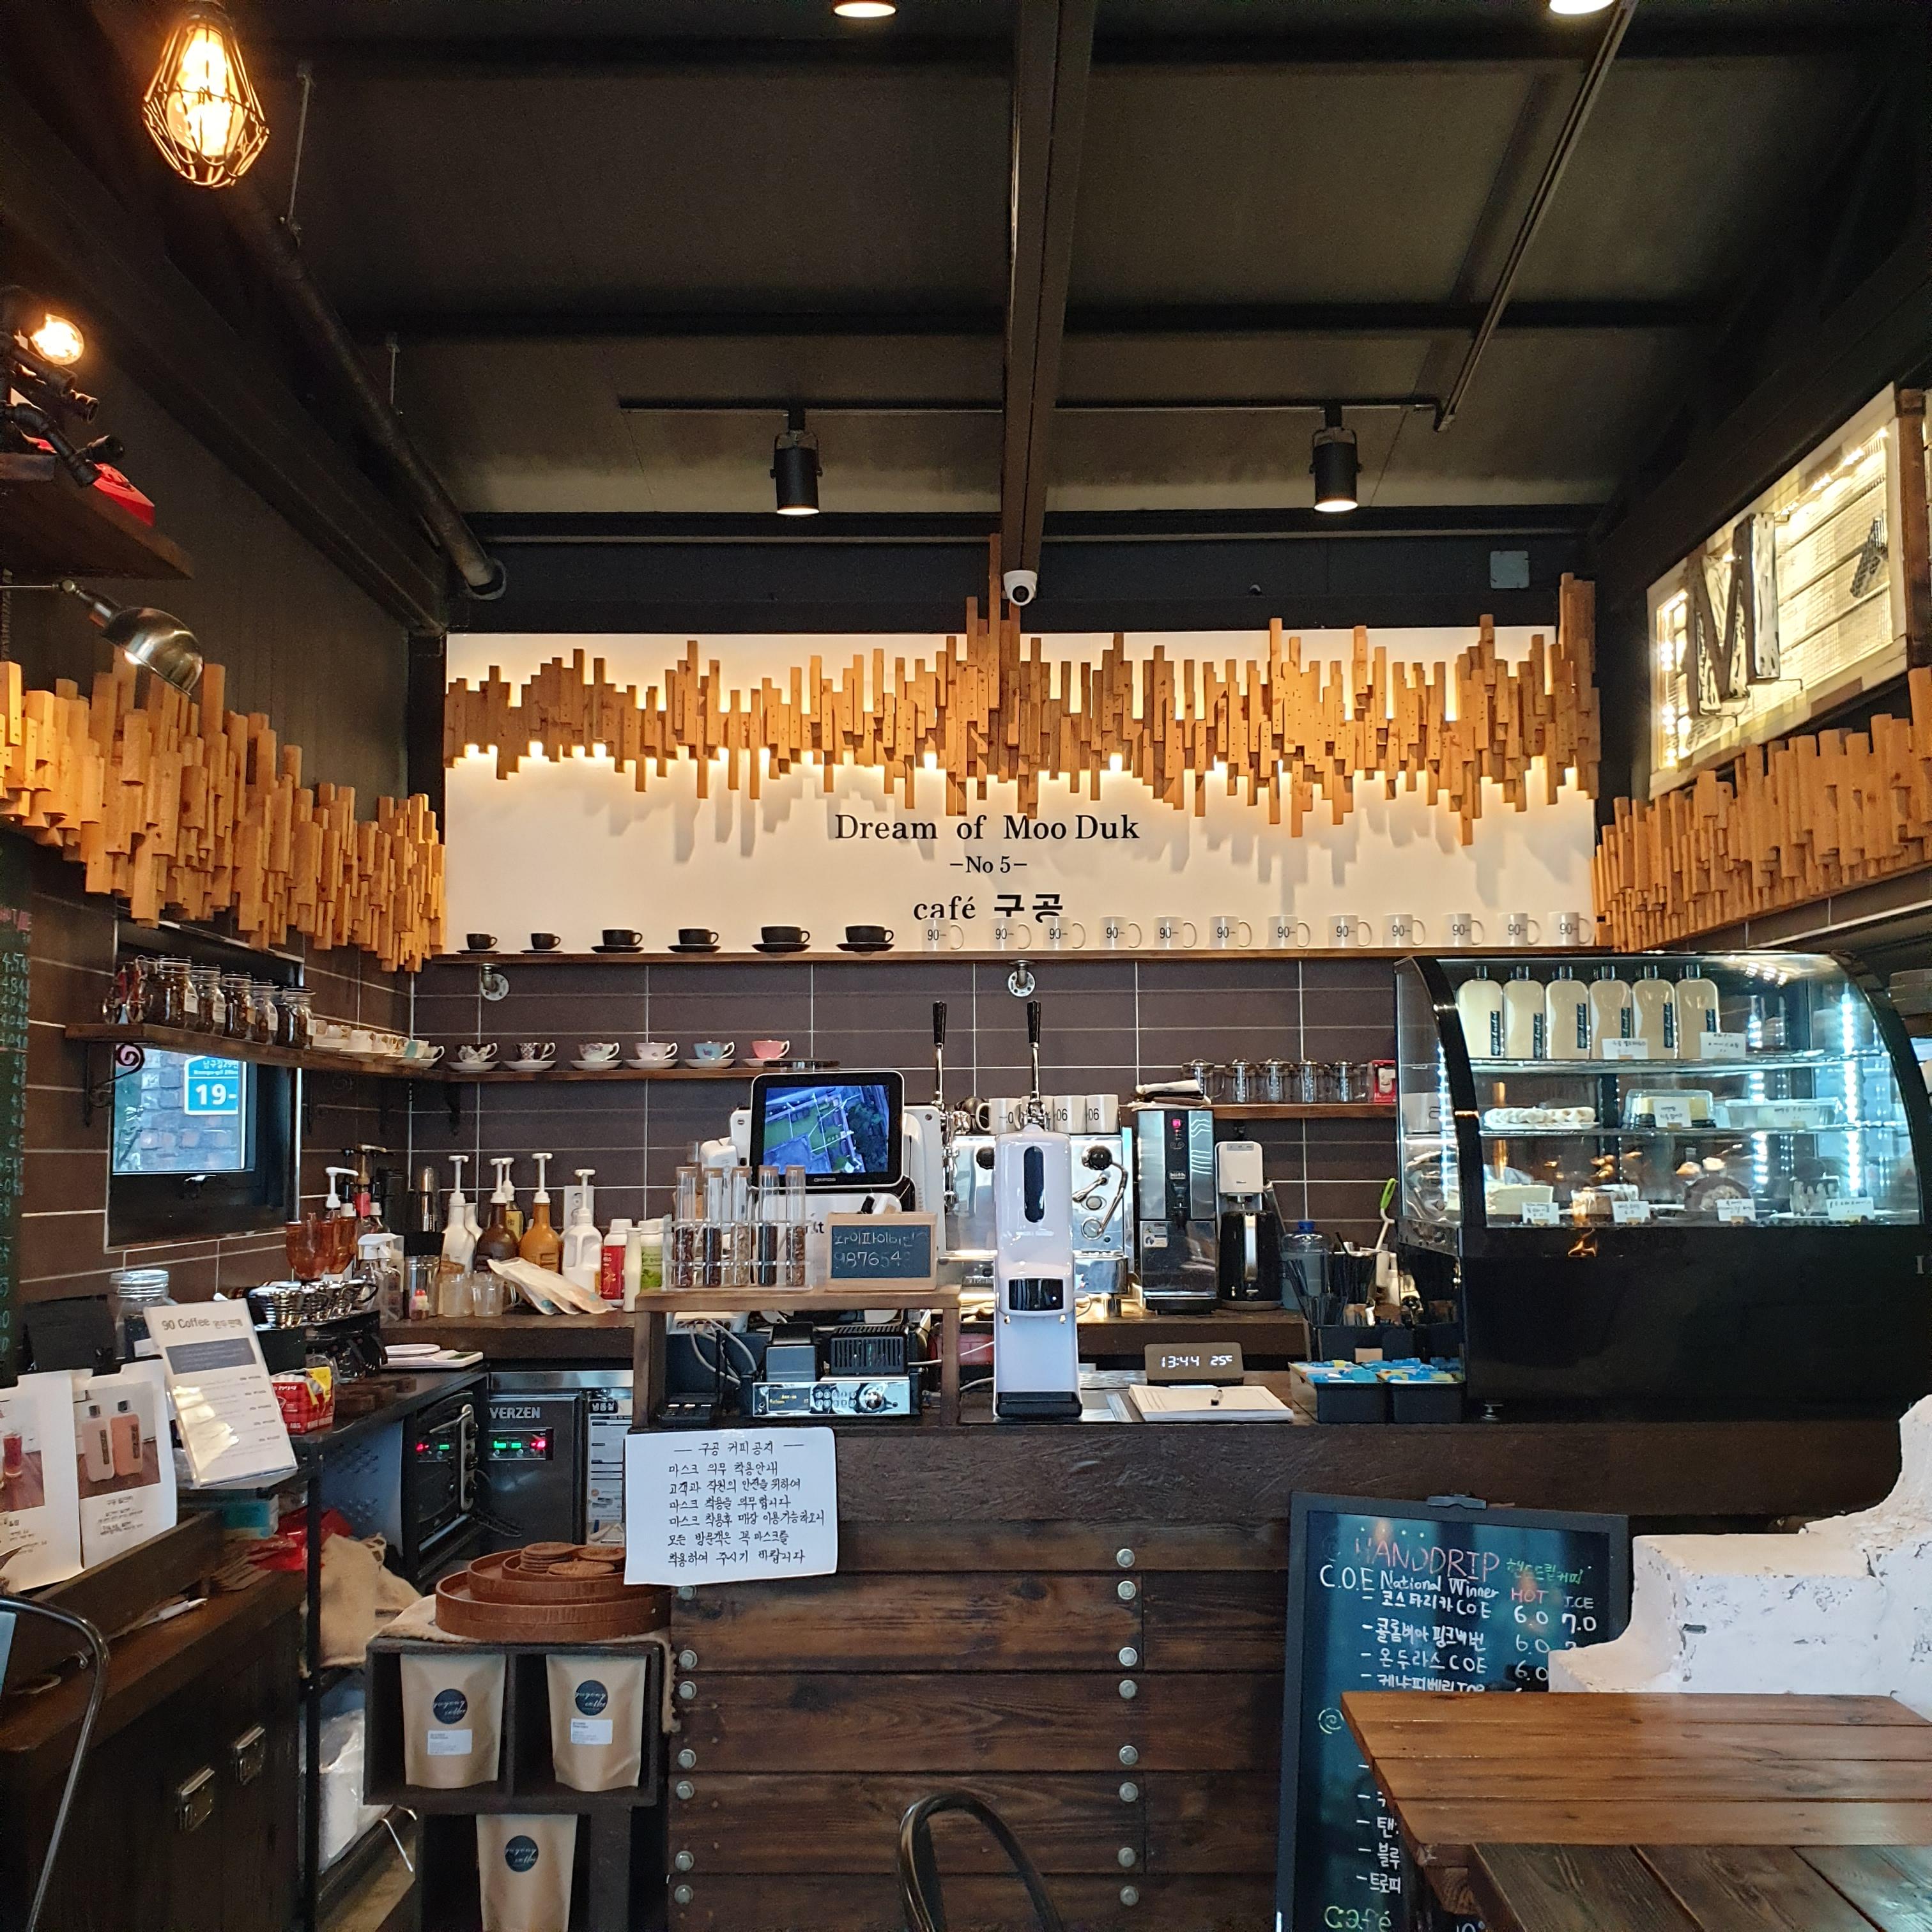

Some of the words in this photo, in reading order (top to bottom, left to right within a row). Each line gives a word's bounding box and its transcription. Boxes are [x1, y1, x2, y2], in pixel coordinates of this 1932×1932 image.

[834, 813, 938, 839] Dream
[957, 815, 987, 839] of
[1003, 815, 1066, 839] Moo
[1075, 815, 1140, 839] Duk
[914, 896, 976, 920] café
[179, 1317, 210, 1329] Coffee
[1160, 1355, 1200, 1368] 13:44
[489, 1406, 540, 1419] VERZEN
[698, 1442, 719, 1457] 구공
[668, 1463, 699, 1477] 마스크
[707, 1462, 727, 1476] 의무
[670, 1482, 701, 1496] 고객과
[707, 1479, 736, 1494] 직원의
[670, 1499, 699, 1513] 마스크
[706, 1497, 732, 1511] 착용을
[670, 1515, 700, 1528] 마스크
[706, 1512, 732, 1528] 착용후
[738, 1512, 758, 1526] 매장
[668, 1533, 686, 1546] 모든
[695, 1531, 732, 1547] 방문객은
[739, 1531, 749, 1546] 꼭
[754, 1530, 789, 1545] 마스크를
[668, 1551, 708, 1567] 착용하여
[716, 1550, 749, 1565] 주시기
[758, 1549, 806, 1565] 바랍니다
[1380, 1570, 1441, 1592] National
[1448, 1577, 1499, 1598] Winner
[1511, 1587, 1549, 1604] HOT
[1381, 1590, 1453, 1612] 코스타리카
[1457, 1599, 1492, 1619] COE
[1514, 1605, 1549, 1627] 6.0
[1561, 1613, 1597, 1634] 7.0
[1515, 1634, 1551, 1655] 6.0
[1379, 1647, 1445, 1669] 온두라스
[1449, 1655, 1488, 1673] COE
[1514, 1659, 1549, 1681] 6.0
